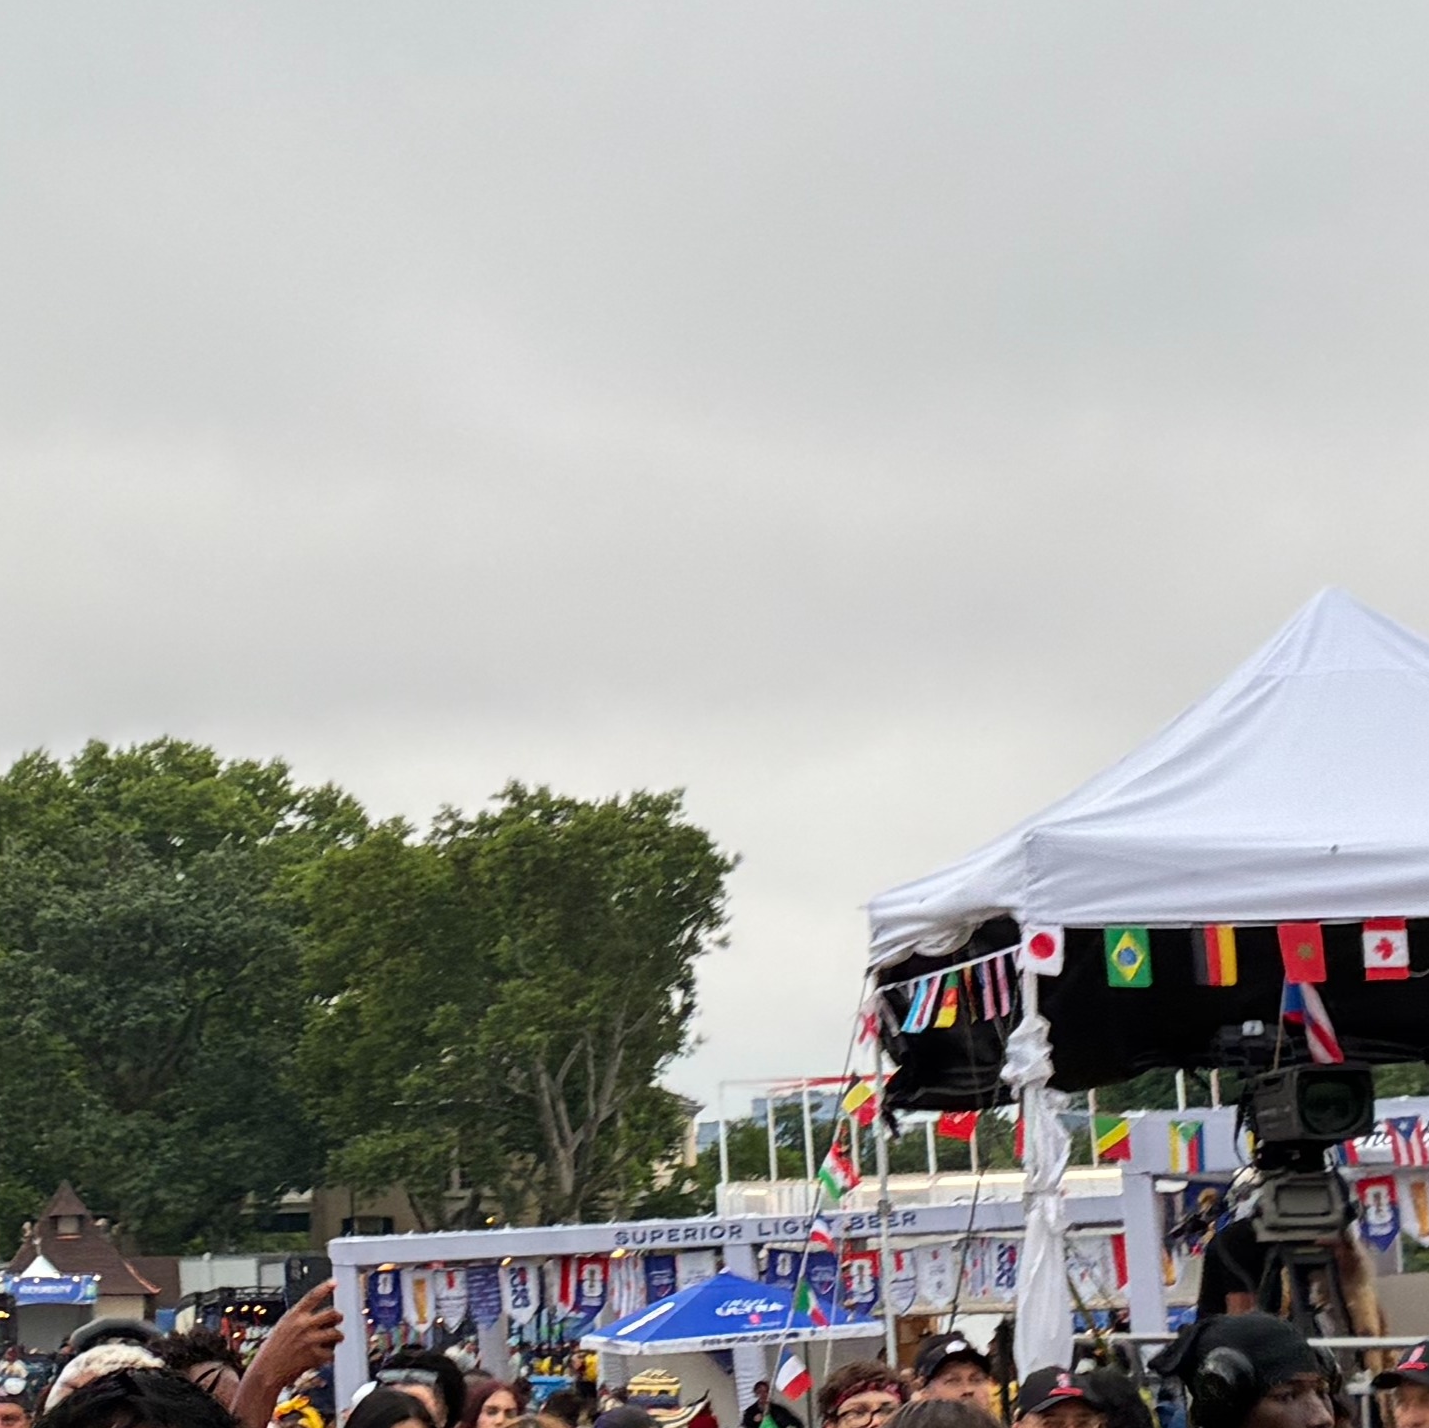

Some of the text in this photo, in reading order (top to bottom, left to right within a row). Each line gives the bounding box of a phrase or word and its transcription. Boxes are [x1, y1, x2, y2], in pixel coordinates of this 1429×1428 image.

[614, 1210, 917, 1246] SUPERIOR LIG BEER
